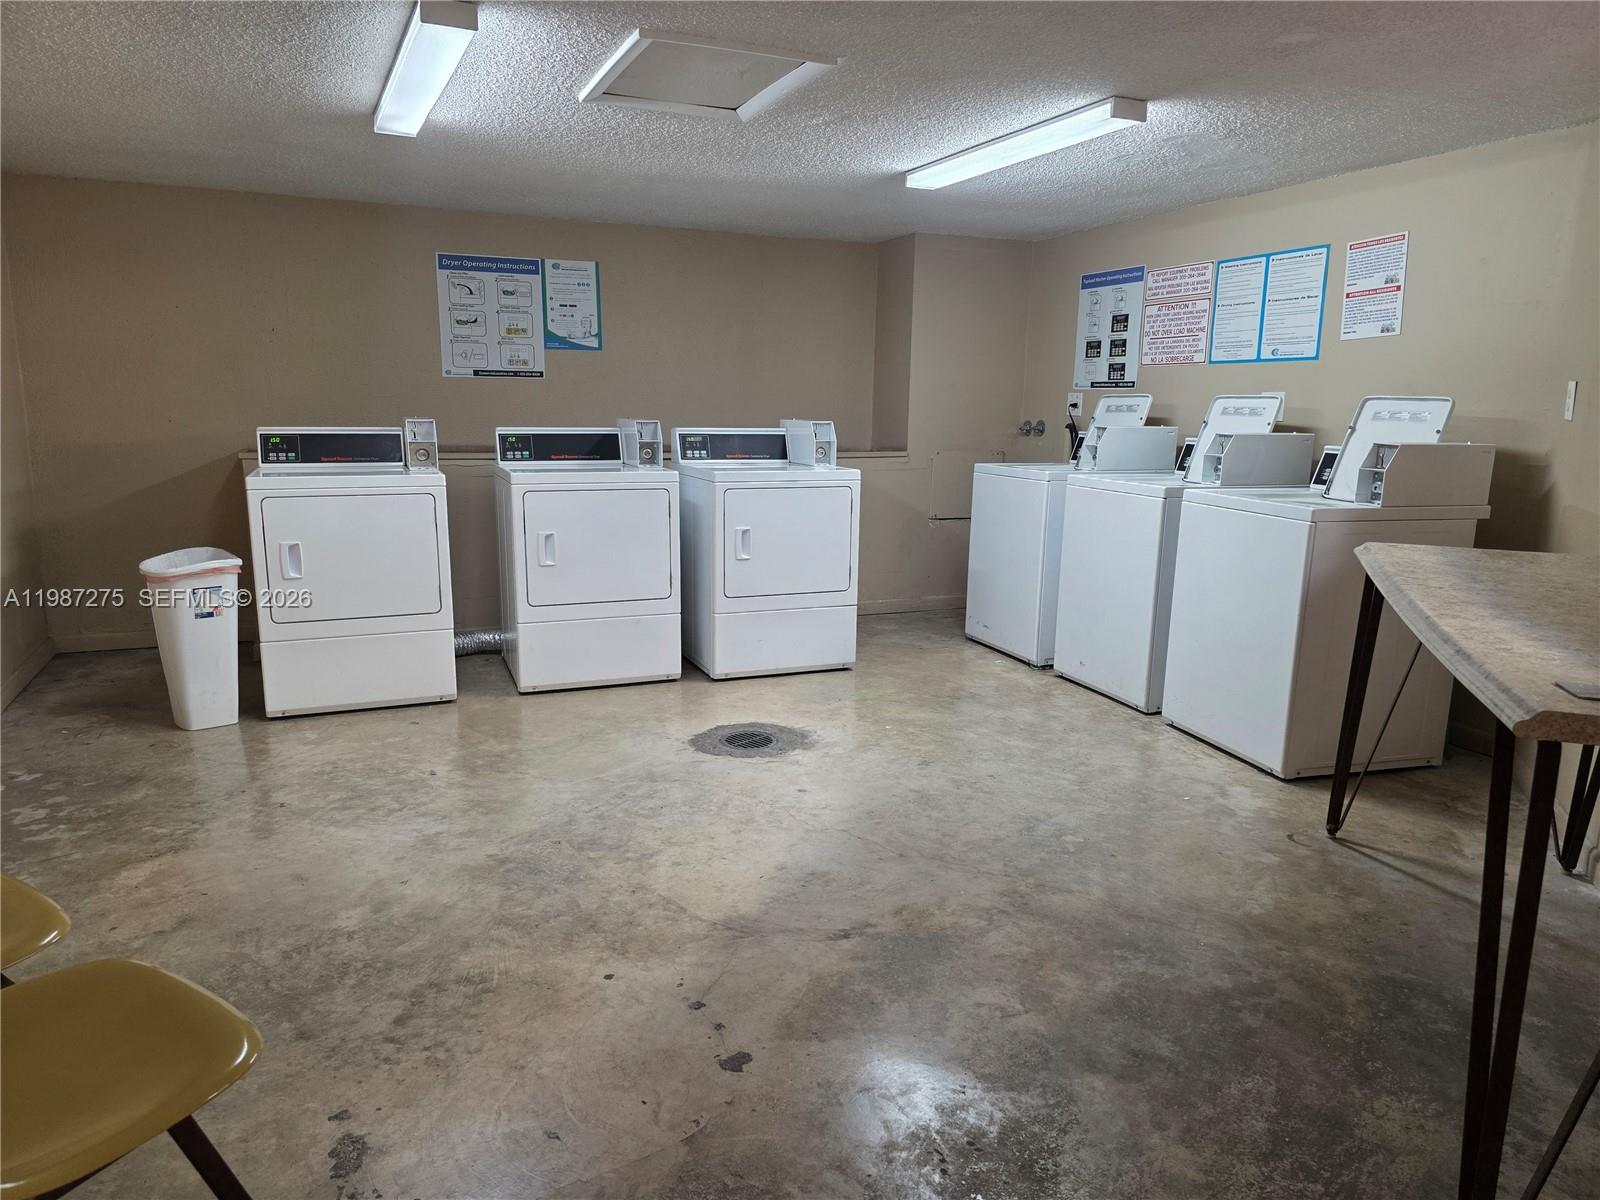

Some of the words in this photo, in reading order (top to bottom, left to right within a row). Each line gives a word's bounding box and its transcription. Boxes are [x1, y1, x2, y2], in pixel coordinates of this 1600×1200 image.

[442, 258, 462, 267] Dryer
[463, 260, 496, 269] Operating
[497, 262, 536, 270] Instructions
[1157, 303, 1189, 312] ATTENTION
